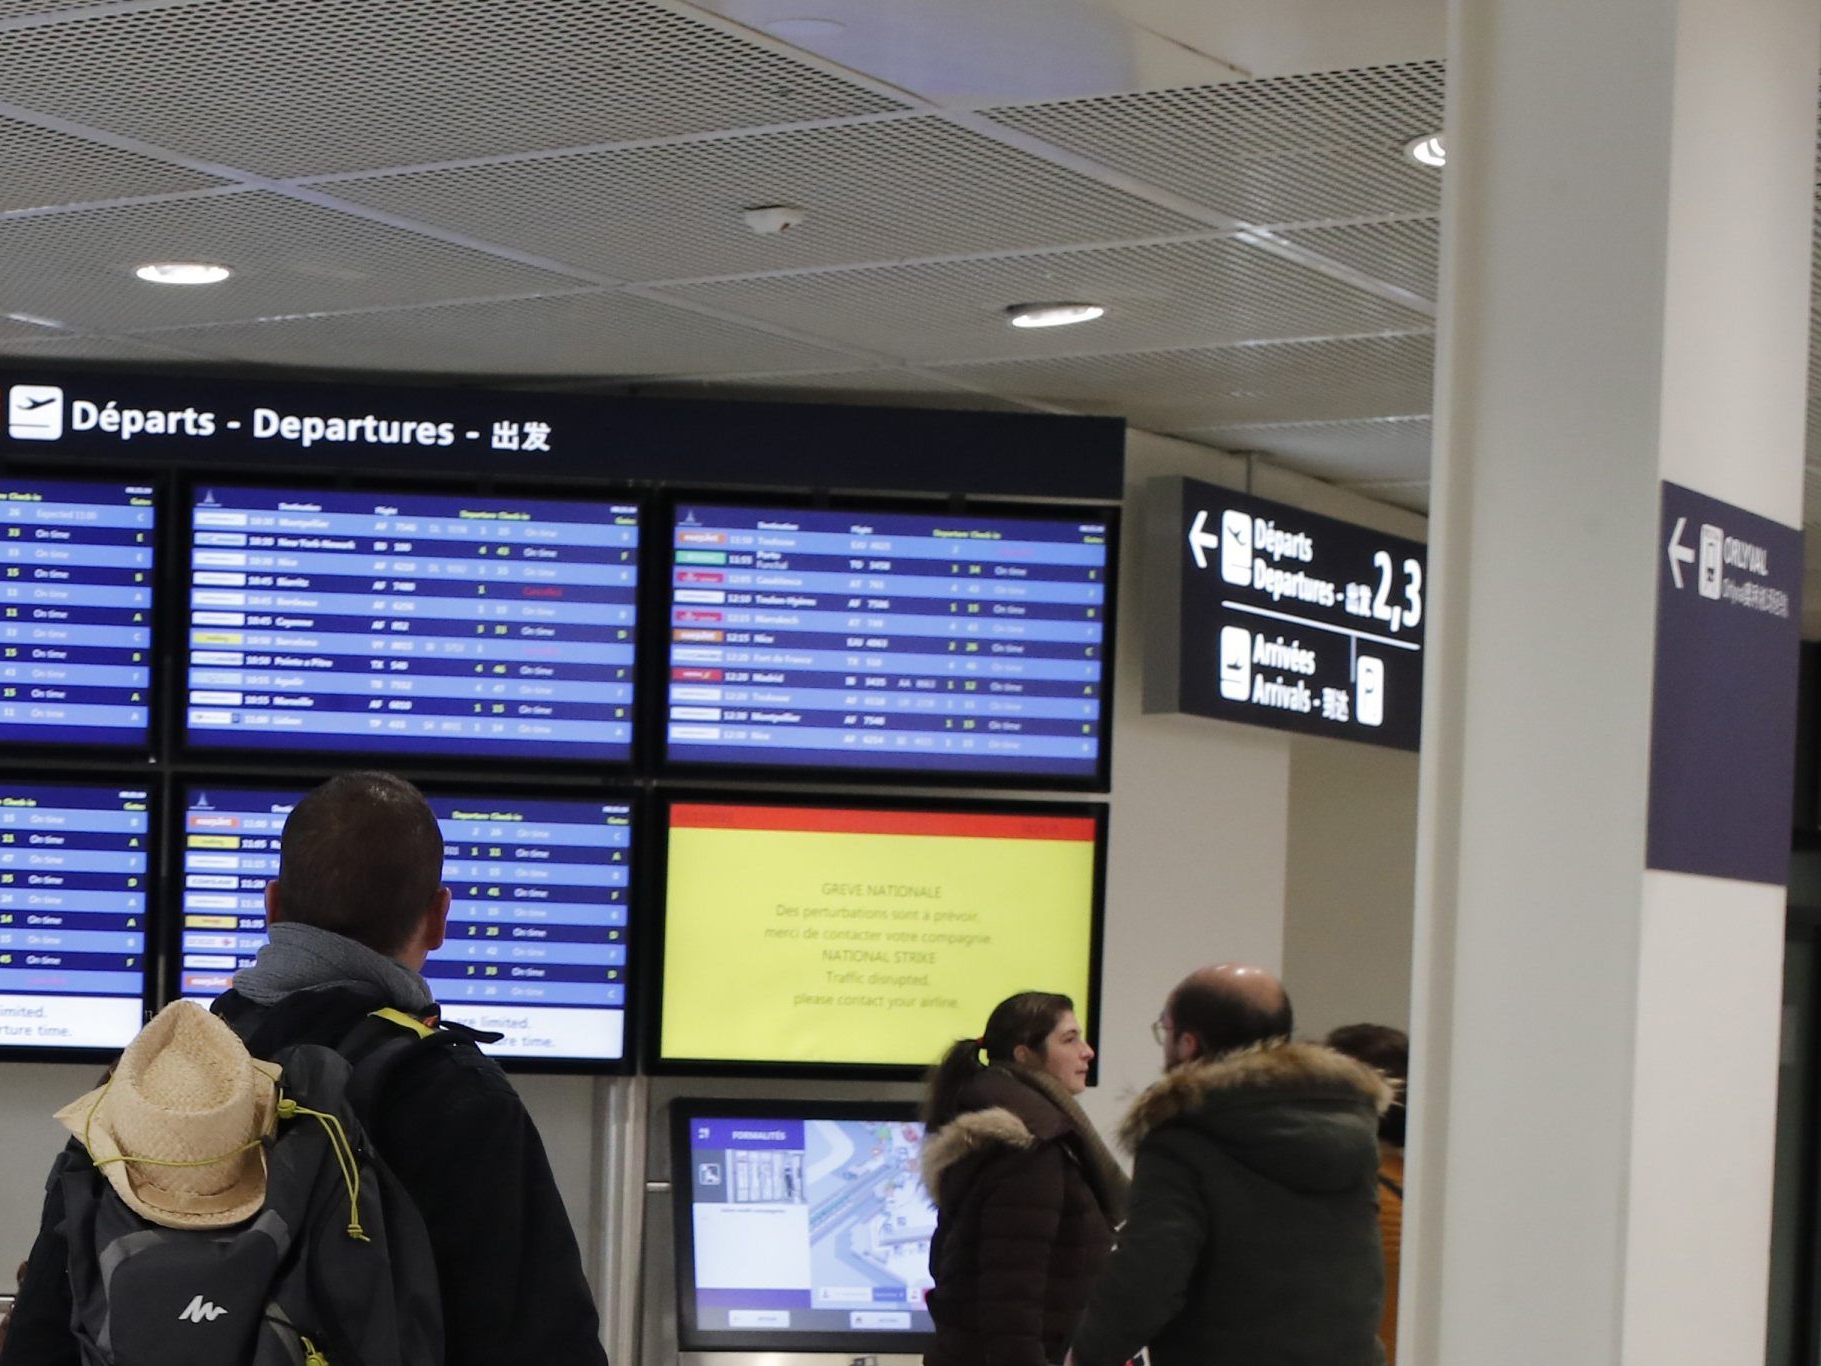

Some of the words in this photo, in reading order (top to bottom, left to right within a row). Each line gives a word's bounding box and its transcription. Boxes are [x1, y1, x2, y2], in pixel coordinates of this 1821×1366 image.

[72, 400, 216, 441] Départs
[253, 407, 455, 447] Departures
[491, 420, 552, 452] 出发
[1254, 517, 1313, 562] Départs
[1253, 557, 1335, 607] Departures
[1373, 550, 1422, 633] 2,3
[1252, 633, 1316, 676] Arrivées
[1252, 673, 1312, 714] Arrivals
[866, 884, 942, 899] NATIONALE
[776, 904, 799, 917] Des
[803, 905, 888, 922] perturbations
[892, 908, 919, 920] sont
[764, 927, 799, 939] merci
[803, 927, 819, 940] de
[823, 929, 881, 941] contacter
[886, 931, 918, 942] votre
[822, 950, 889, 964] NATIONAL
[894, 950, 936, 965] STRIKE
[826, 971, 864, 985] Traffic
[793, 993, 833, 1007] please
[836, 994, 884, 1008] contact
[887, 997, 917, 1010] your
[38, 1023, 73, 1036] time.
